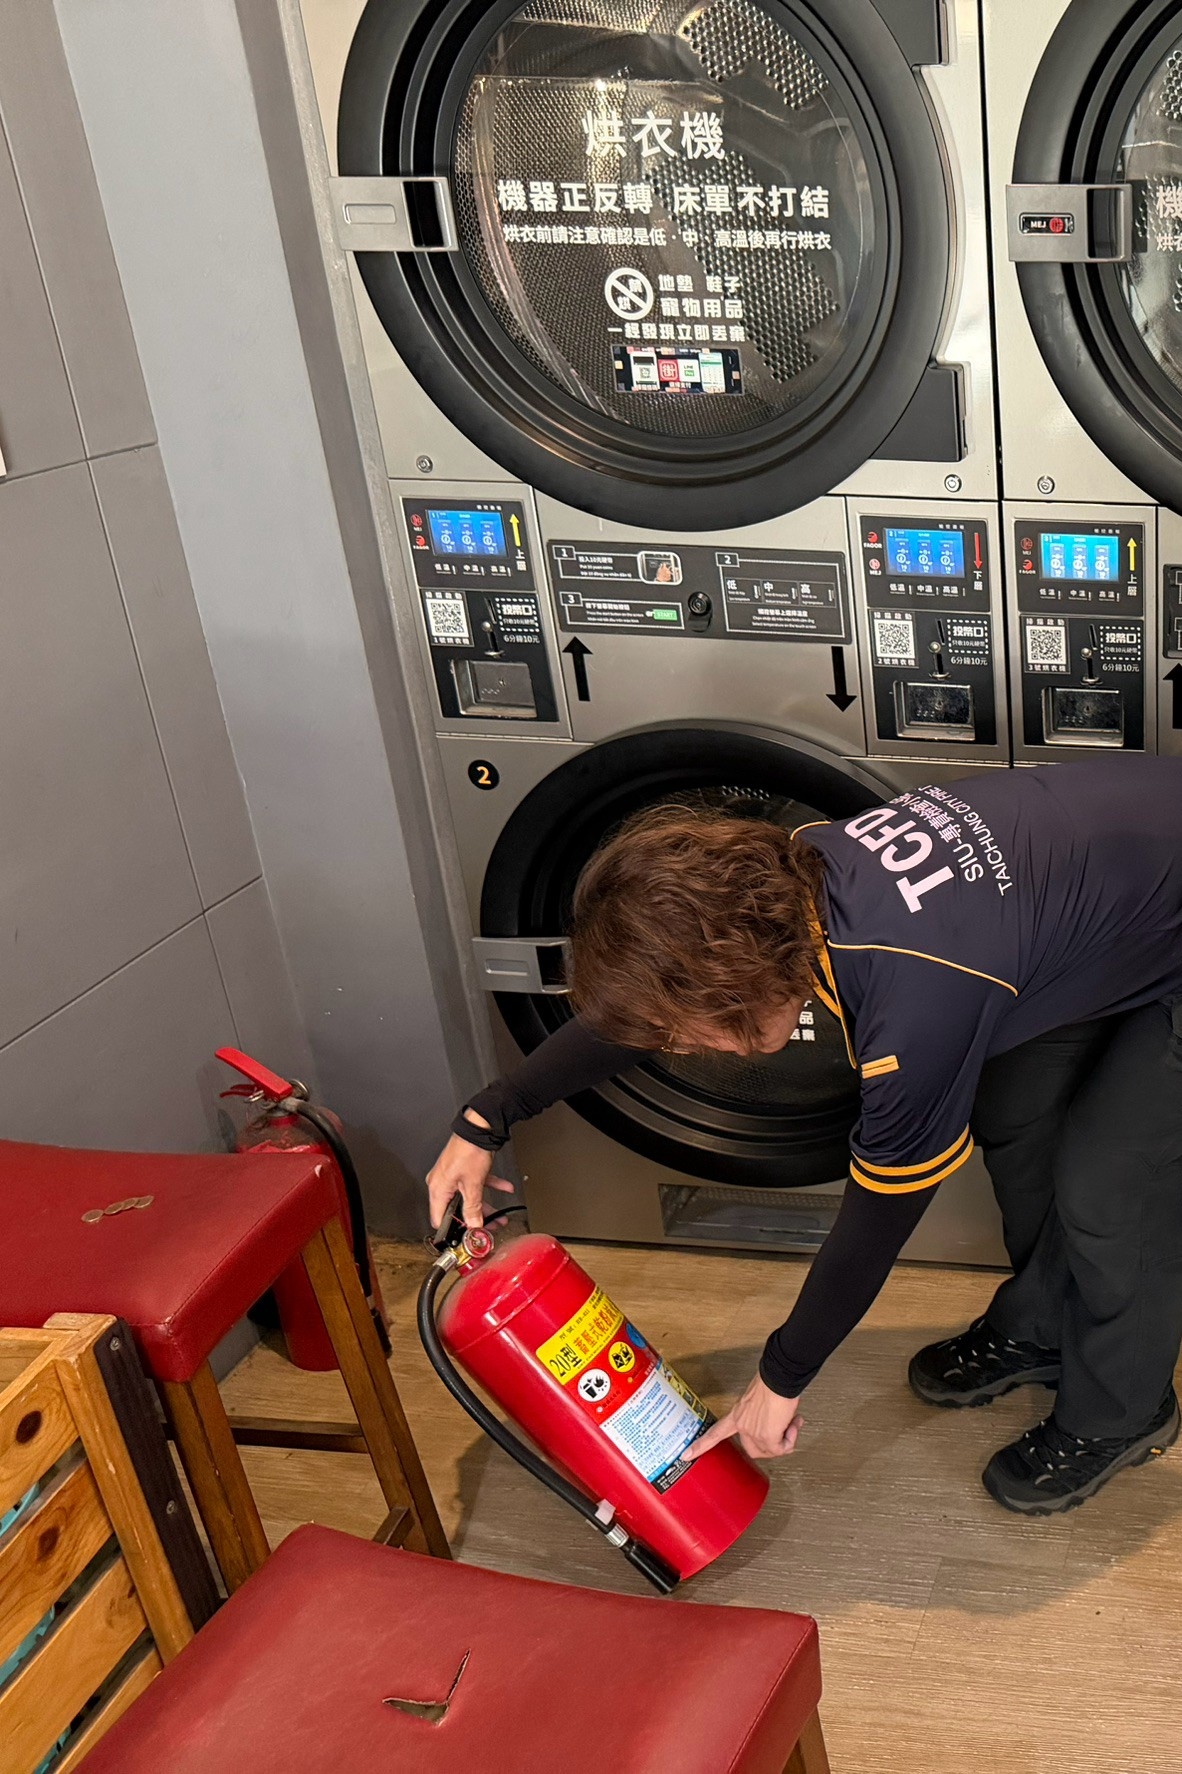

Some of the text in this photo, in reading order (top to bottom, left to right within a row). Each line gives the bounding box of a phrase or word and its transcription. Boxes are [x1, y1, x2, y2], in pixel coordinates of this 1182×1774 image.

[582, 110, 725, 160] 烘衣機
[497, 180, 829, 218] 機器正反轉 床單不打結
[658, 274, 741, 293] 地墊 鞋子
[660, 297, 744, 319] 寵物用品
[561, 548, 568, 558] 1
[724, 555, 731, 564] 2
[763, 582, 774, 592] 中
[800, 584, 811, 594] 高
[568, 594, 575, 604] 3
[501, 604, 533, 616] 投幣口
[952, 626, 984, 637] 投幣口
[1105, 632, 1137, 644] 投幣口
[477, 766, 491, 785] 2
[947, 797, 971, 814] CITY
[844, 807, 955, 913] TCFD
[963, 811, 1013, 897] TAICHUNG
[549, 1343, 583, 1379] 20型
